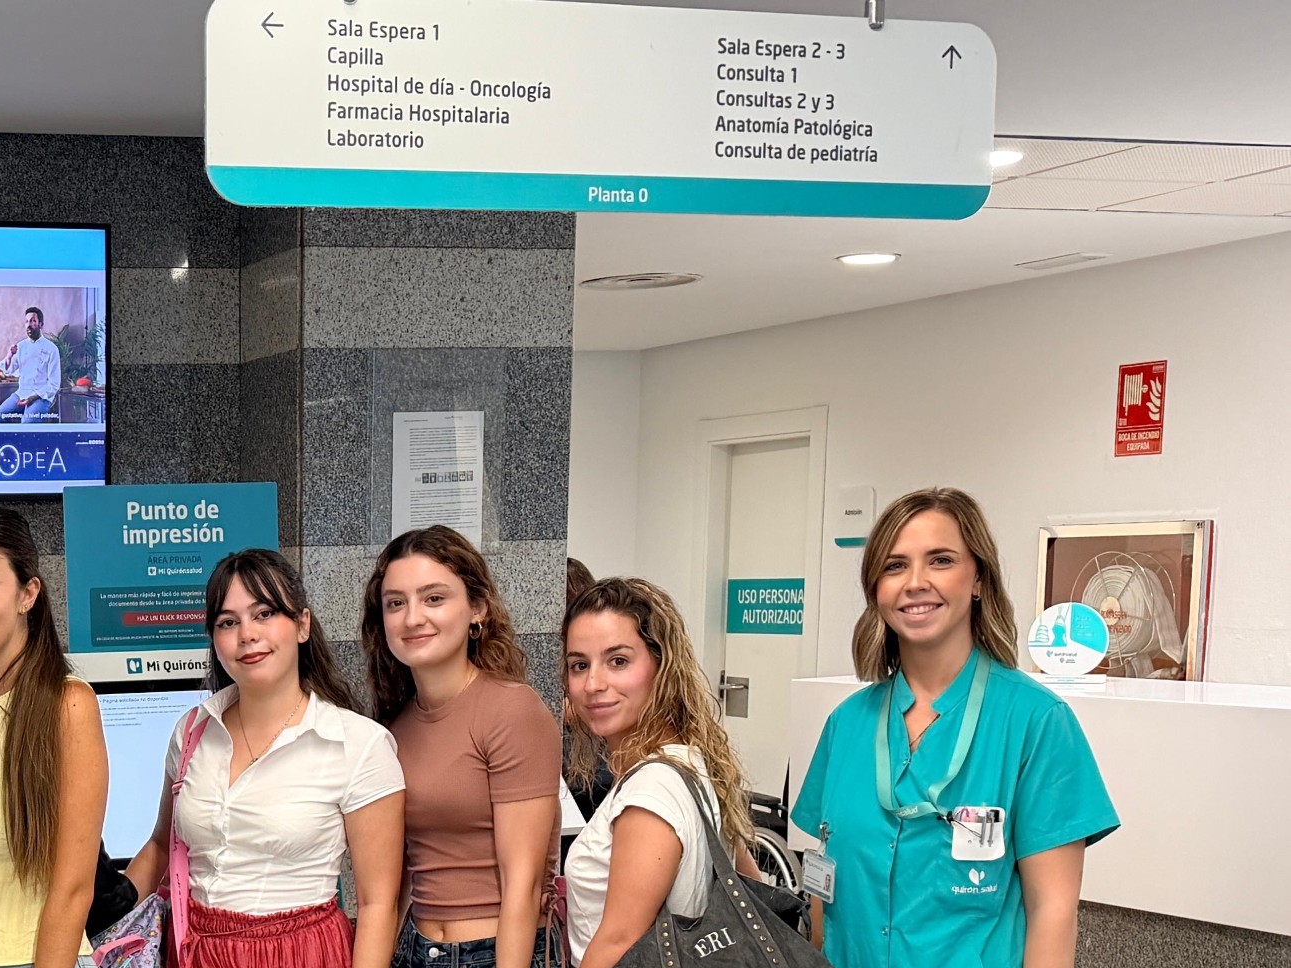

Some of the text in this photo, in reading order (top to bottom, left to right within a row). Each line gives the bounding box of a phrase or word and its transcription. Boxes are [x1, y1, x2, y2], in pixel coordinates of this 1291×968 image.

[327, 19, 440, 43] Sala Espera 1
[327, 46, 384, 69] Capilla
[717, 37, 751, 56] Sala
[755, 39, 807, 60] Espera
[811, 42, 821, 59] 2
[836, 43, 846, 60] 3
[716, 63, 798, 83] Consulta 1
[327, 74, 398, 96] Hospital
[403, 77, 424, 95] de
[429, 78, 454, 95] día
[470, 79, 552, 102] Oncología
[716, 89, 835, 113] Consultas 2 y 3
[327, 101, 510, 126] Farmacia Hospitalaria
[327, 129, 424, 149] Laboratorio
[715, 115, 874, 140] Anatomía Patológica
[714, 141, 879, 164] Consulta de pediatría
[588, 186, 648, 203] Planta 0
[126, 499, 220, 521] Punto de
[122, 522, 224, 548] impresión
[170, 555, 202, 564] PRIVADA
[737, 588, 805, 605] USO PERSONA
[176, 613, 206, 621] RESPONSA
[742, 608, 804, 625] AUTORIZADO
[147, 659, 213, 673] Mi Quirónsa
[694, 926, 737, 958] ERI
